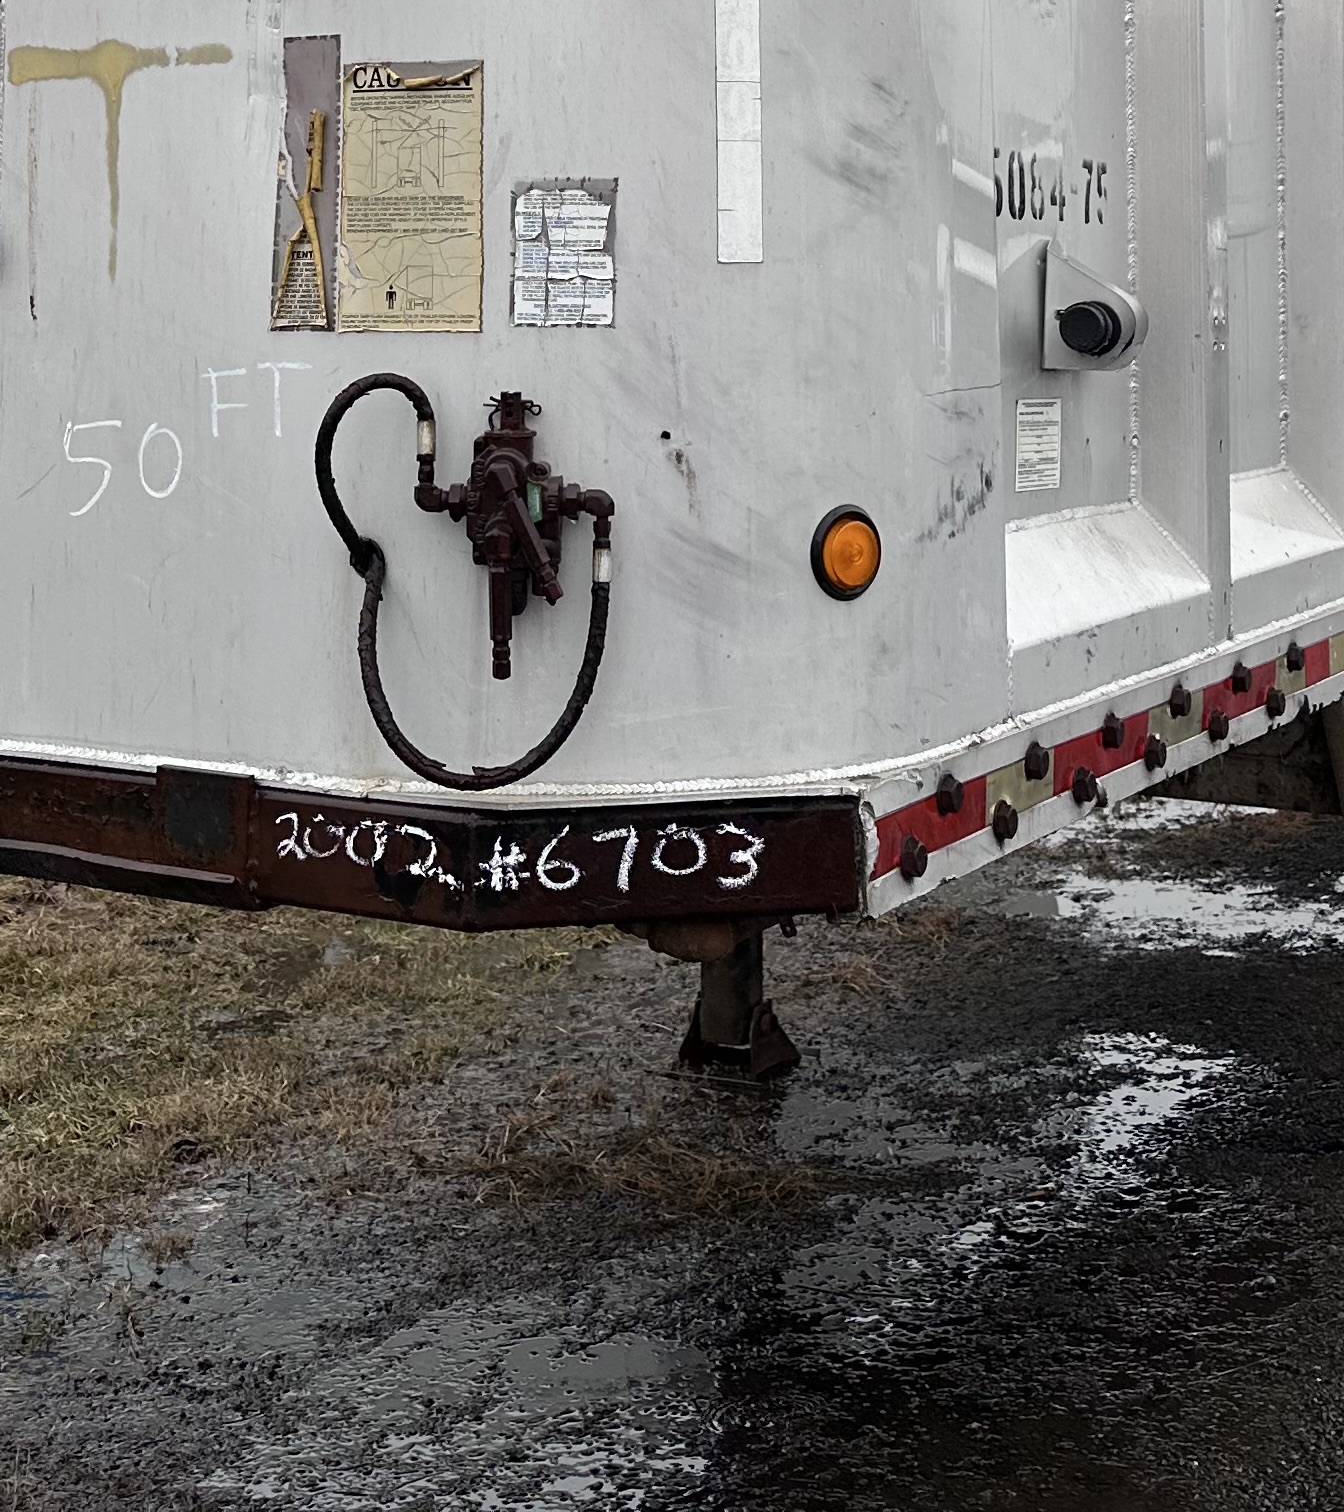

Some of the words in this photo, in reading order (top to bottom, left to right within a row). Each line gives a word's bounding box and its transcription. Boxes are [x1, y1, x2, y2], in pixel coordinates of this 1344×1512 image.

[63, 420, 183, 517] 50
[201, 361, 315, 438] FT
[473, 823, 765, 892] #6703
